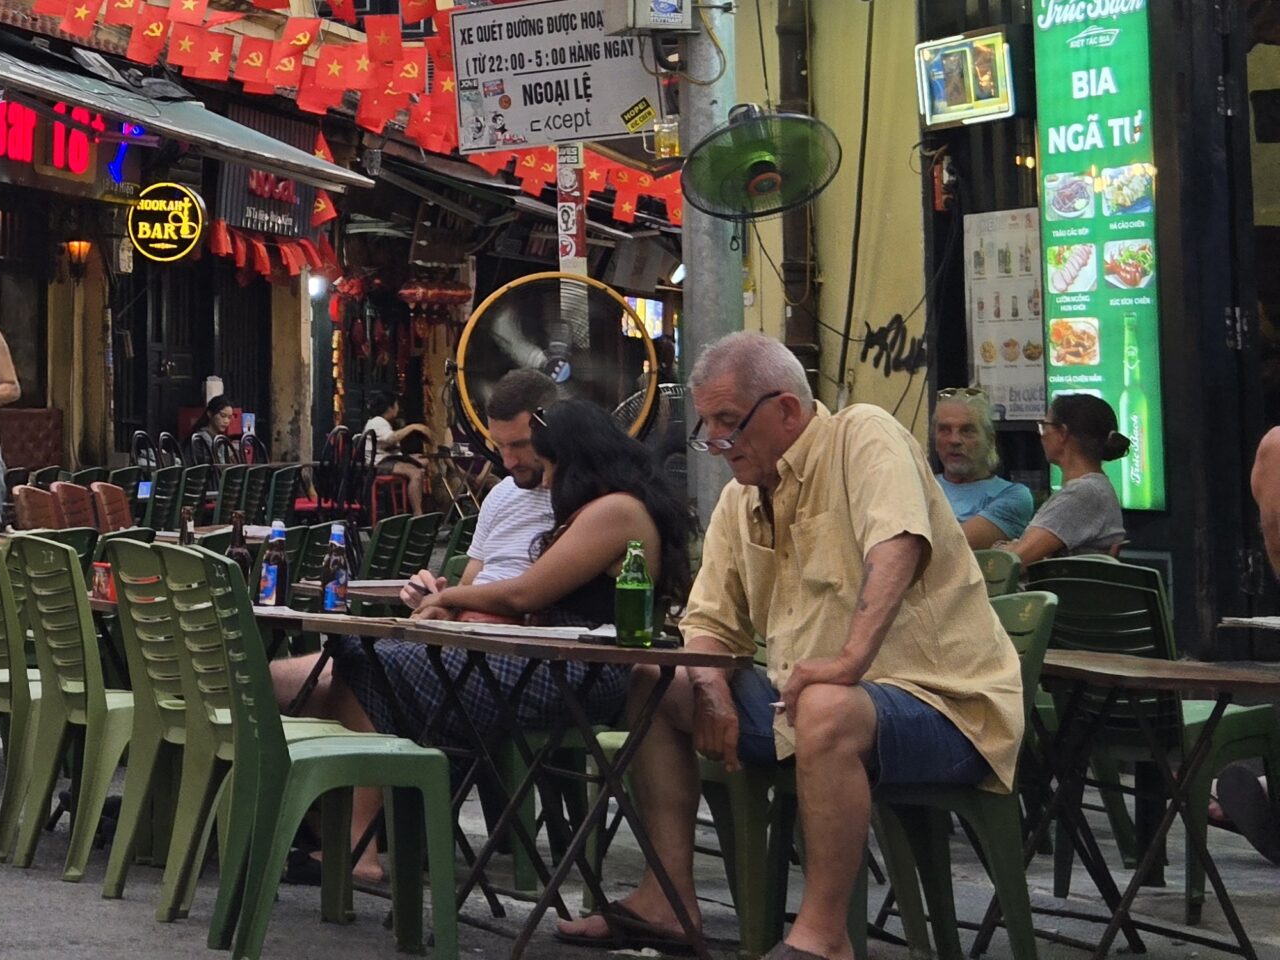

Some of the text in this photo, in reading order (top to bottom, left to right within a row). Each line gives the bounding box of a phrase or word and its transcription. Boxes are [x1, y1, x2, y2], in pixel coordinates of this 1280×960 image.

[459, 9, 605, 46] XE QUÉT ĐƯỜNG ĐƯỢC HOẠ
[569, 39, 601, 64] HÀNG
[522, 79, 570, 107] NGOẠI
[574, 72, 593, 103] LỆ
[1072, 66, 1119, 100] BIA
[1048, 109, 1145, 155] NGÃ TƯ
[138, 222, 178, 240] BAR
